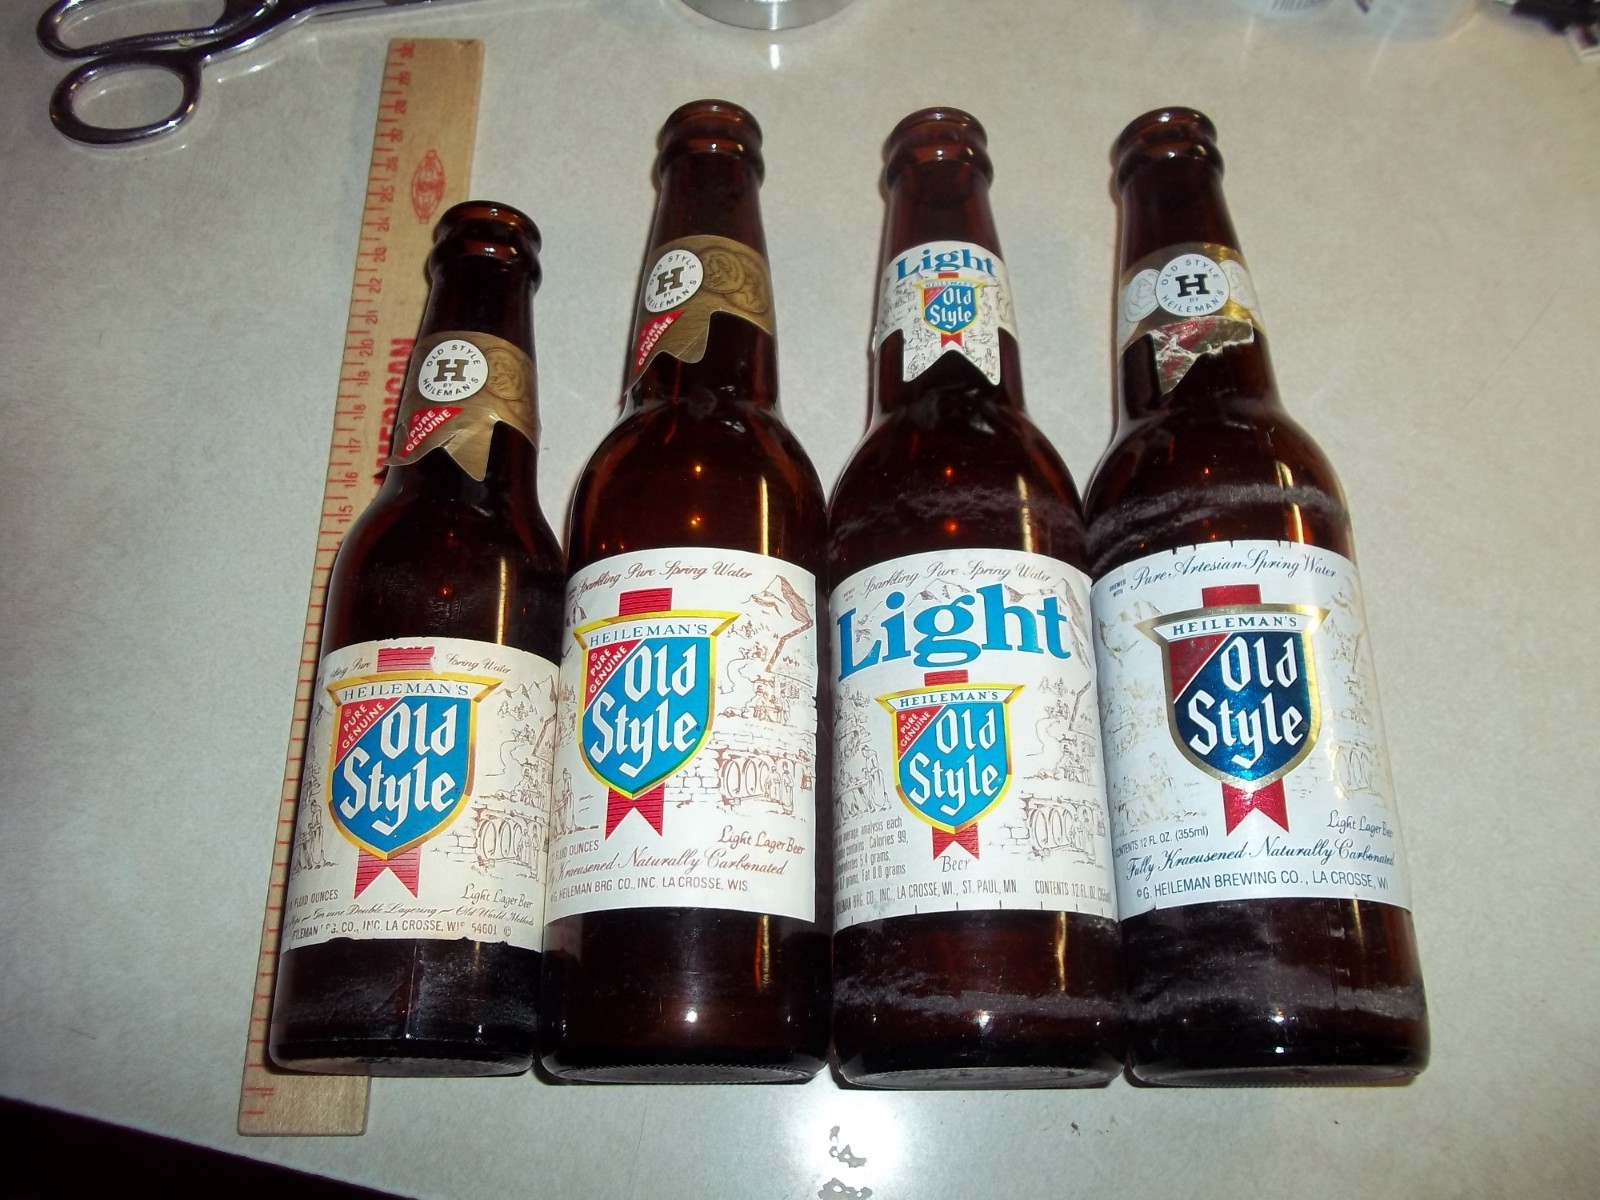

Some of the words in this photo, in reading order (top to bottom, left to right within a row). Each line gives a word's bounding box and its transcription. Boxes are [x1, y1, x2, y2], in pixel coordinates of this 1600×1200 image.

[380, 186, 395, 202] 25
[377, 217, 390, 232] 24
[374, 247, 387, 262] 23
[668, 254, 696, 270] STYLE
[896, 249, 996, 282] Light
[655, 266, 684, 296] H
[1162, 265, 1178, 285] OLD
[1185, 259, 1220, 279] STYLE
[370, 278, 382, 293] 22
[943, 287, 971, 305] Old
[1175, 273, 1210, 298] H
[1162, 289, 1225, 313] HEILEMAN'S
[366, 310, 378, 325] 21
[930, 304, 972, 329] Style
[360, 338, 374, 357] 20
[638, 316, 674, 366] GENUINE
[640, 321, 660, 351] PURE
[426, 348, 444, 367] OLD
[452, 344, 481, 365] STYLE
[357, 370, 370, 387] 19
[433, 359, 469, 382] H
[422, 377, 479, 396] HEILEMAN'S
[353, 403, 366, 421] 18
[410, 410, 435, 438] PURE
[406, 409, 451, 451] GENUINE
[348, 438, 361, 454] 17
[345, 471, 358, 488] 16
[338, 505, 353, 523] 15
[624, 563, 656, 579] Pure
[660, 561, 708, 581] Spring
[712, 561, 753, 579] Water
[859, 569, 920, 599] Sparkling
[920, 561, 958, 578] Pure
[962, 560, 1011, 580] Spring
[1015, 563, 1051, 582] Water
[1130, 566, 1167, 590] Pure
[1168, 555, 1244, 579] Artesian
[1241, 549, 1300, 577] Spring
[1302, 554, 1337, 578] Water
[590, 624, 707, 647] HEILEMAN'S
[837, 583, 1072, 682] Light
[1172, 614, 1298, 636] HEILEMAN'S
[350, 658, 372, 671] Pure
[589, 645, 628, 693] GENUINE
[590, 648, 612, 676] PURE
[625, 643, 696, 702] Old
[1220, 635, 1299, 692] Old
[344, 682, 469, 701] HEILEMAN'S
[900, 690, 998, 708] HEILEMAN'S
[342, 702, 385, 749] GENUINE
[343, 704, 368, 732] PURE
[900, 712, 919, 734] PURE
[900, 711, 931, 747] GENUINE
[1188, 689, 1303, 769] Style
[381, 701, 458, 760] Old
[589, 691, 697, 778] Style
[936, 707, 996, 754] Old
[339, 746, 456, 836] Style
[909, 752, 999, 816] Style
[861, 820, 883, 835] analysis
[886, 815, 903, 829] each
[1327, 809, 1356, 834] Light
[1359, 815, 1382, 838] Lager
[569, 839, 599, 856] OUNCES
[717, 824, 752, 846] Light
[754, 830, 786, 854] Lager
[786, 836, 806, 855] Beer
[869, 834, 895, 849] Calories
[1115, 840, 1138, 858] CONTENTS
[1140, 837, 1147, 848] 12
[1159, 831, 1173, 843] OZ.
[1175, 825, 1209, 841] (355ml)
[556, 852, 619, 882] Kraeusened
[618, 845, 702, 874] Naturally
[700, 847, 789, 877] Carbonated
[942, 856, 972, 873] Beer
[1126, 855, 1155, 881] Fully
[1158, 842, 1248, 871] Kraeusened
[1248, 835, 1336, 865] Naturally
[1334, 838, 1395, 865] Carbonated
[862, 869, 870, 882] Fat
[885, 864, 906, 878] grams
[1154, 875, 1210, 897] HEILEMAN
[1215, 870, 1277, 888] BREWING
[1280, 870, 1308, 886] CO.,
[1312, 870, 1328, 884] LA
[1331, 871, 1376, 890] CROSSE,
[311, 889, 339, 904] OUNCES
[460, 882, 490, 905] Light
[493, 888, 518, 908] Lager
[518, 893, 534, 909] Beer
[559, 882, 592, 900] HEILEMAN
[662, 877, 677, 888] LA
[678, 877, 724, 891] CROSSE,
[897, 885, 906, 899] LA
[908, 881, 940, 898] CROSSE,
[962, 881, 975, 895] ST.
[1003, 880, 1019, 894] MN.
[1034, 880, 1069, 896] CONTENTS
[1072, 883, 1079, 897] 12
[346, 902, 384, 916] Double
[384, 903, 437, 918] Lagering
[455, 906, 477, 917] Old
[477, 908, 506, 920] World
[505, 912, 535, 926] Methods
[385, 920, 398, 931] LA
[402, 920, 443, 932] CROSSE,
[471, 922, 498, 935] 54601
